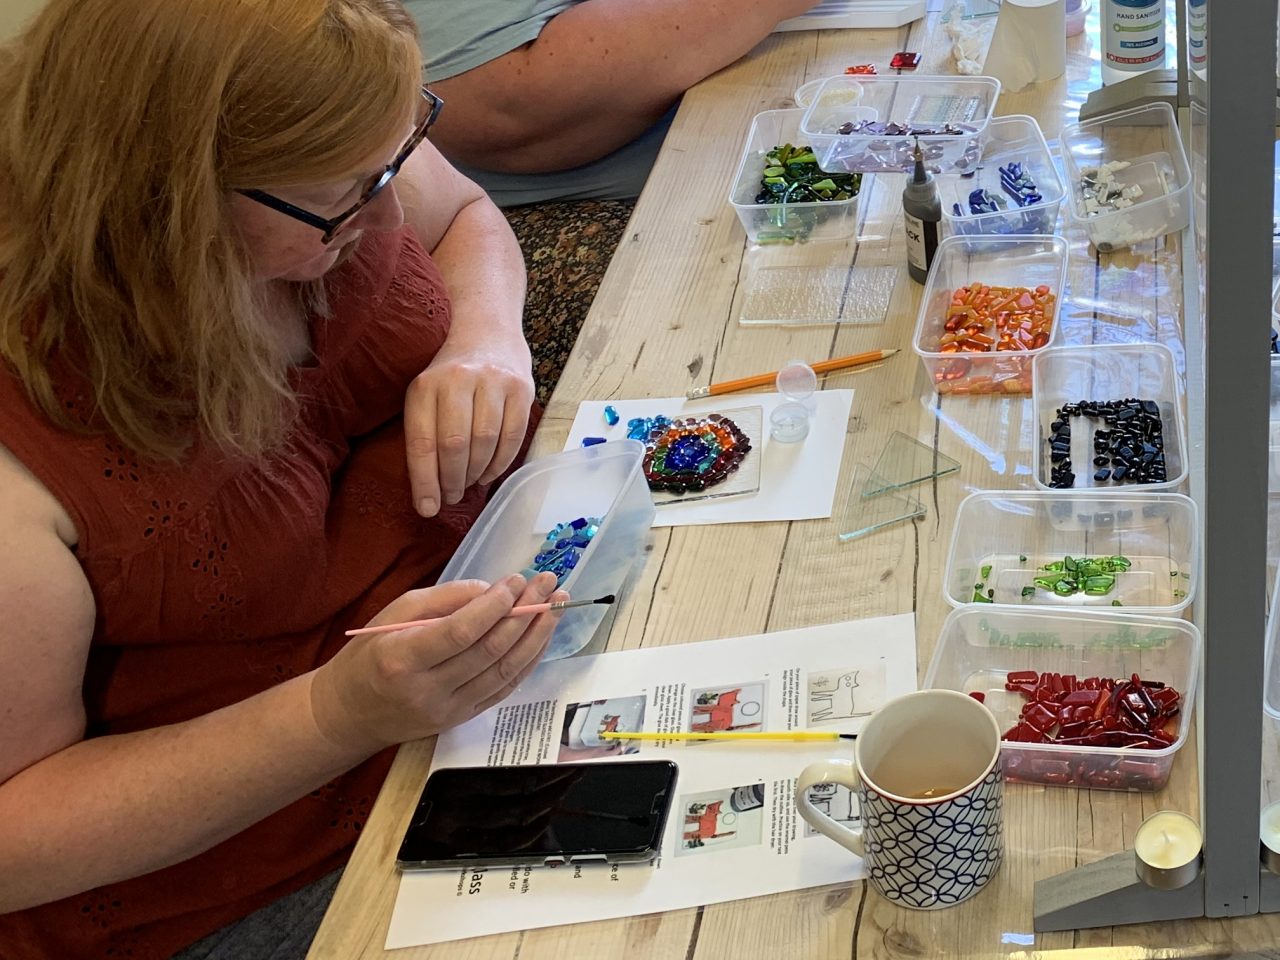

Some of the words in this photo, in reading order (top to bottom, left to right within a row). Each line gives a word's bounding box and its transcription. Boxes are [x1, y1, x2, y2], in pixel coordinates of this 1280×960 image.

[1116, 11, 1134, 19] HAND
[523, 867, 532, 877] do
[574, 865, 583, 879] and
[611, 874, 619, 882] of
[509, 882, 516, 890] or
[521, 877, 530, 894] with
